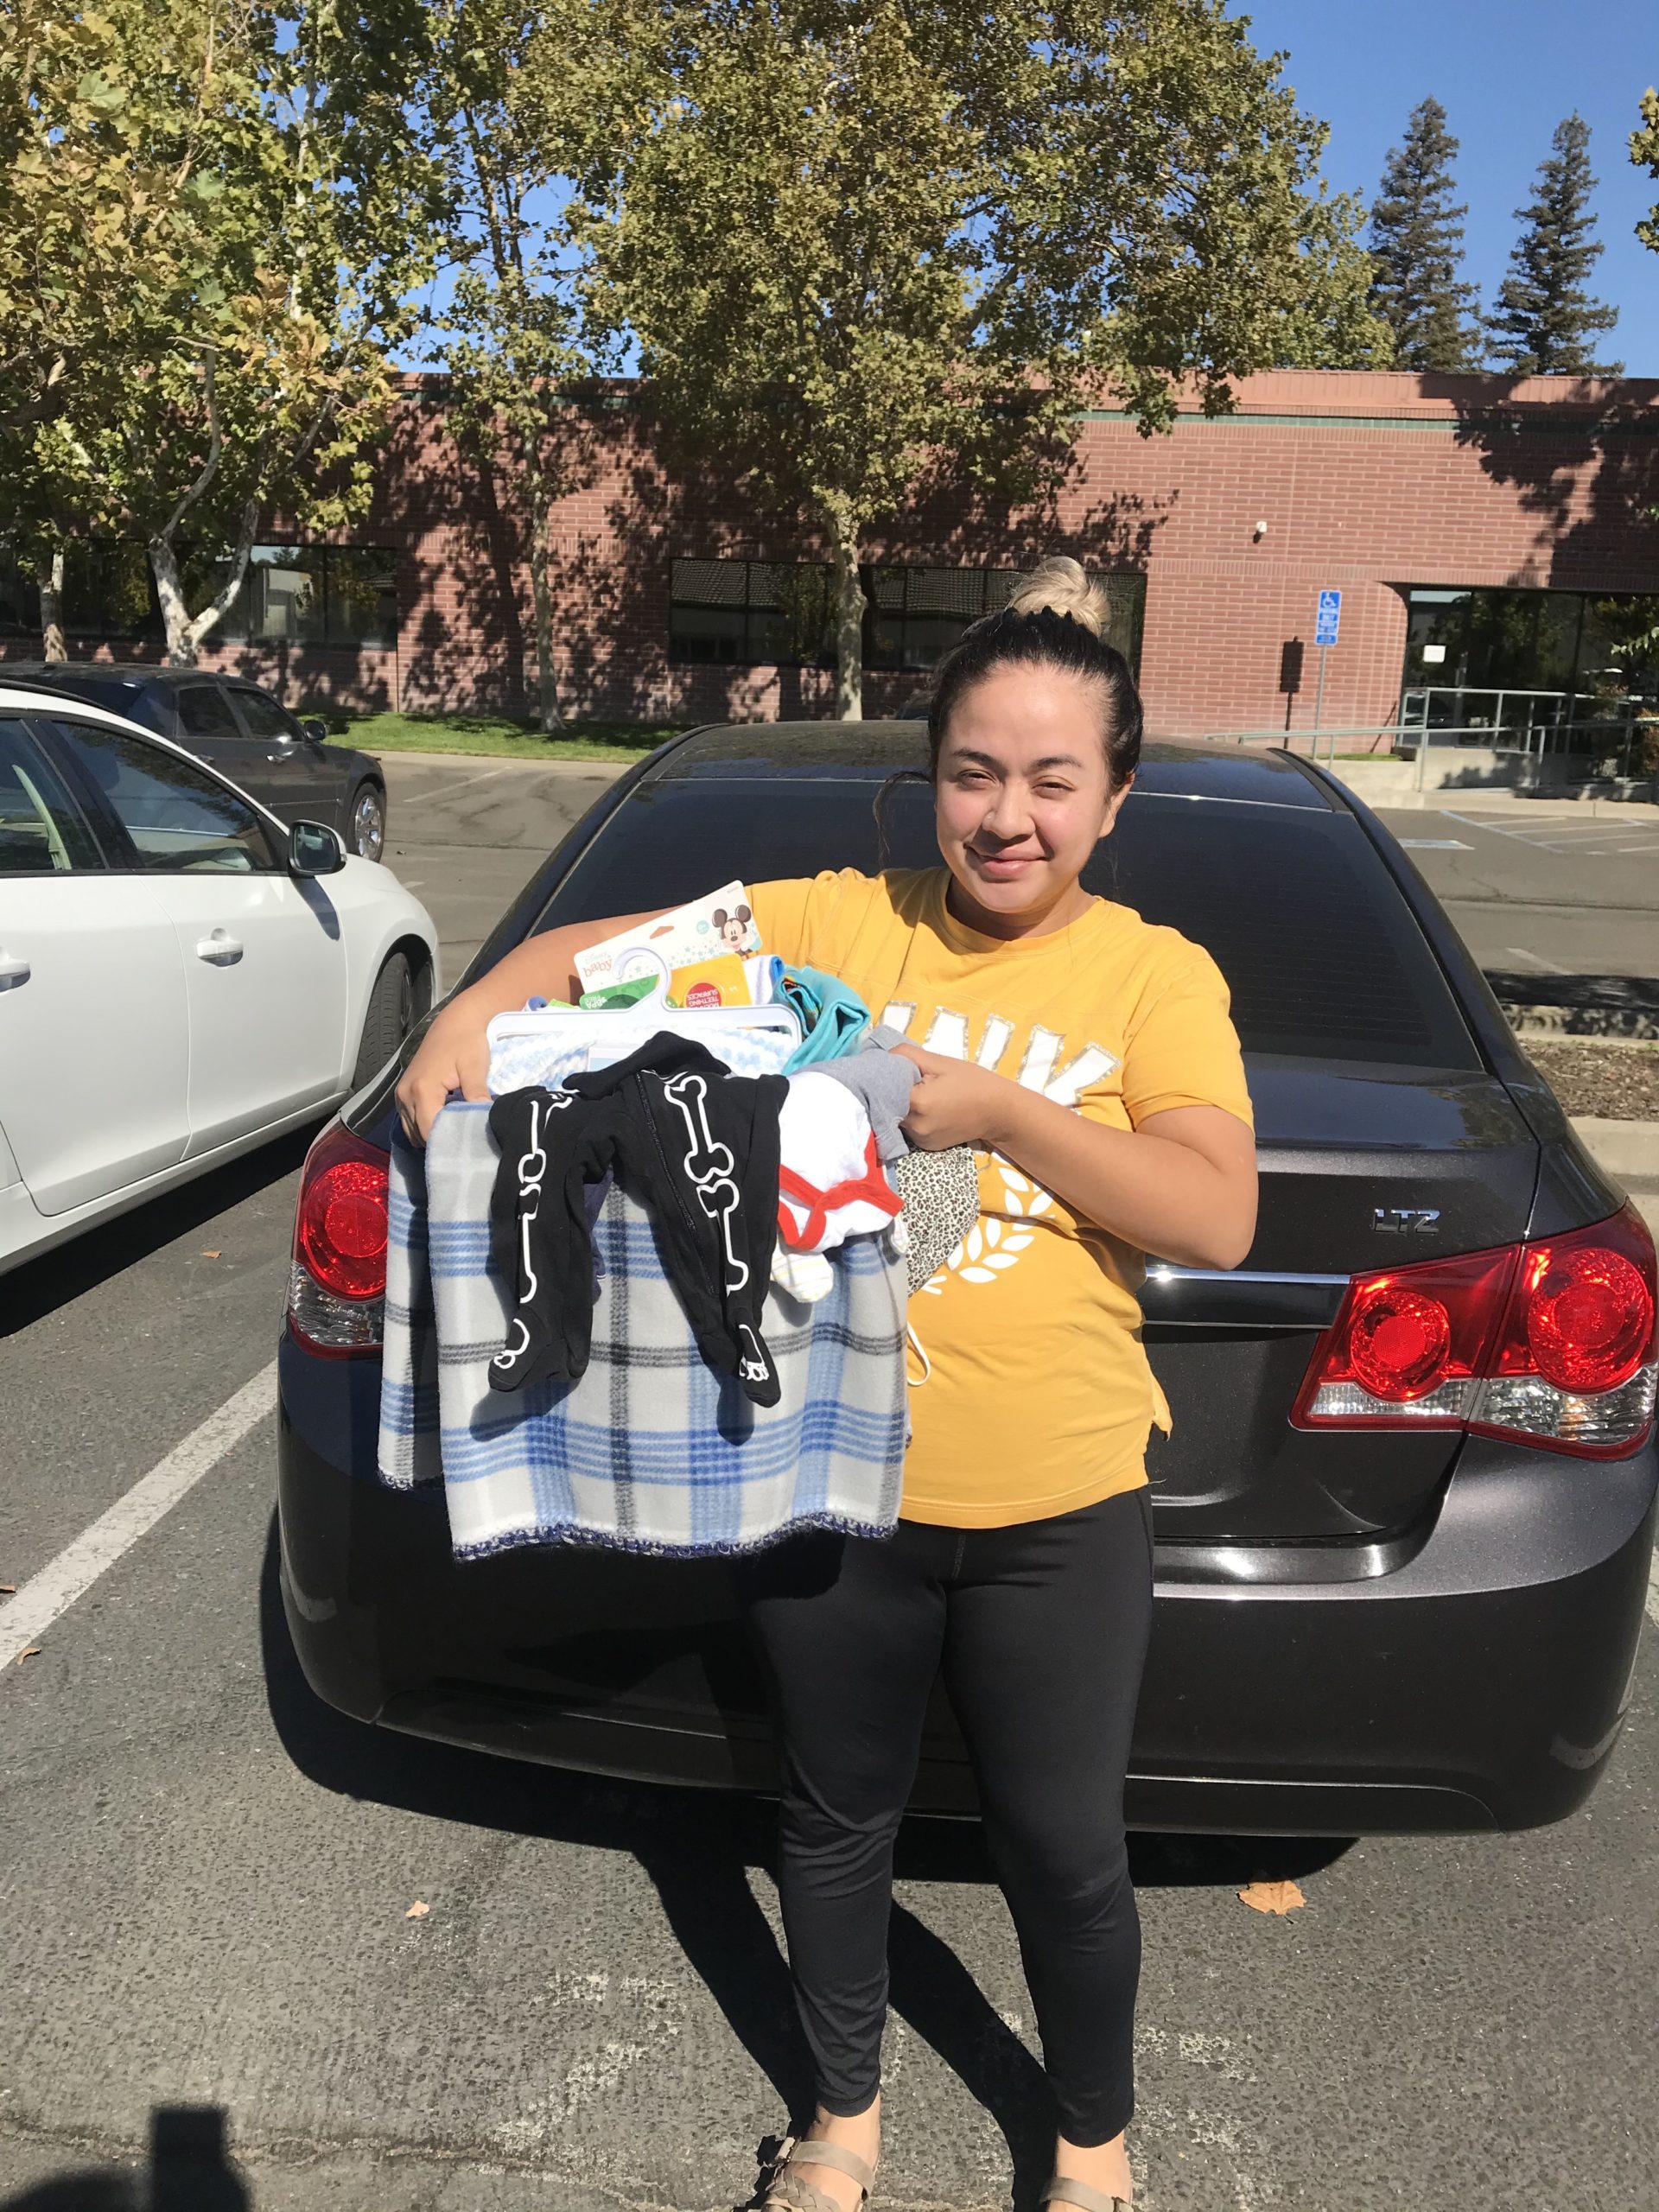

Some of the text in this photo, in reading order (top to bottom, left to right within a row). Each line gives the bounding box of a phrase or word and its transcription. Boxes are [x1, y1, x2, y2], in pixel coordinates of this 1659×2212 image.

[582, 958, 612, 977] baby
[688, 989, 718, 1000] SURFACES
[689, 995, 719, 1007] TEETHING
[1373, 1209, 1440, 1234] LTZ
